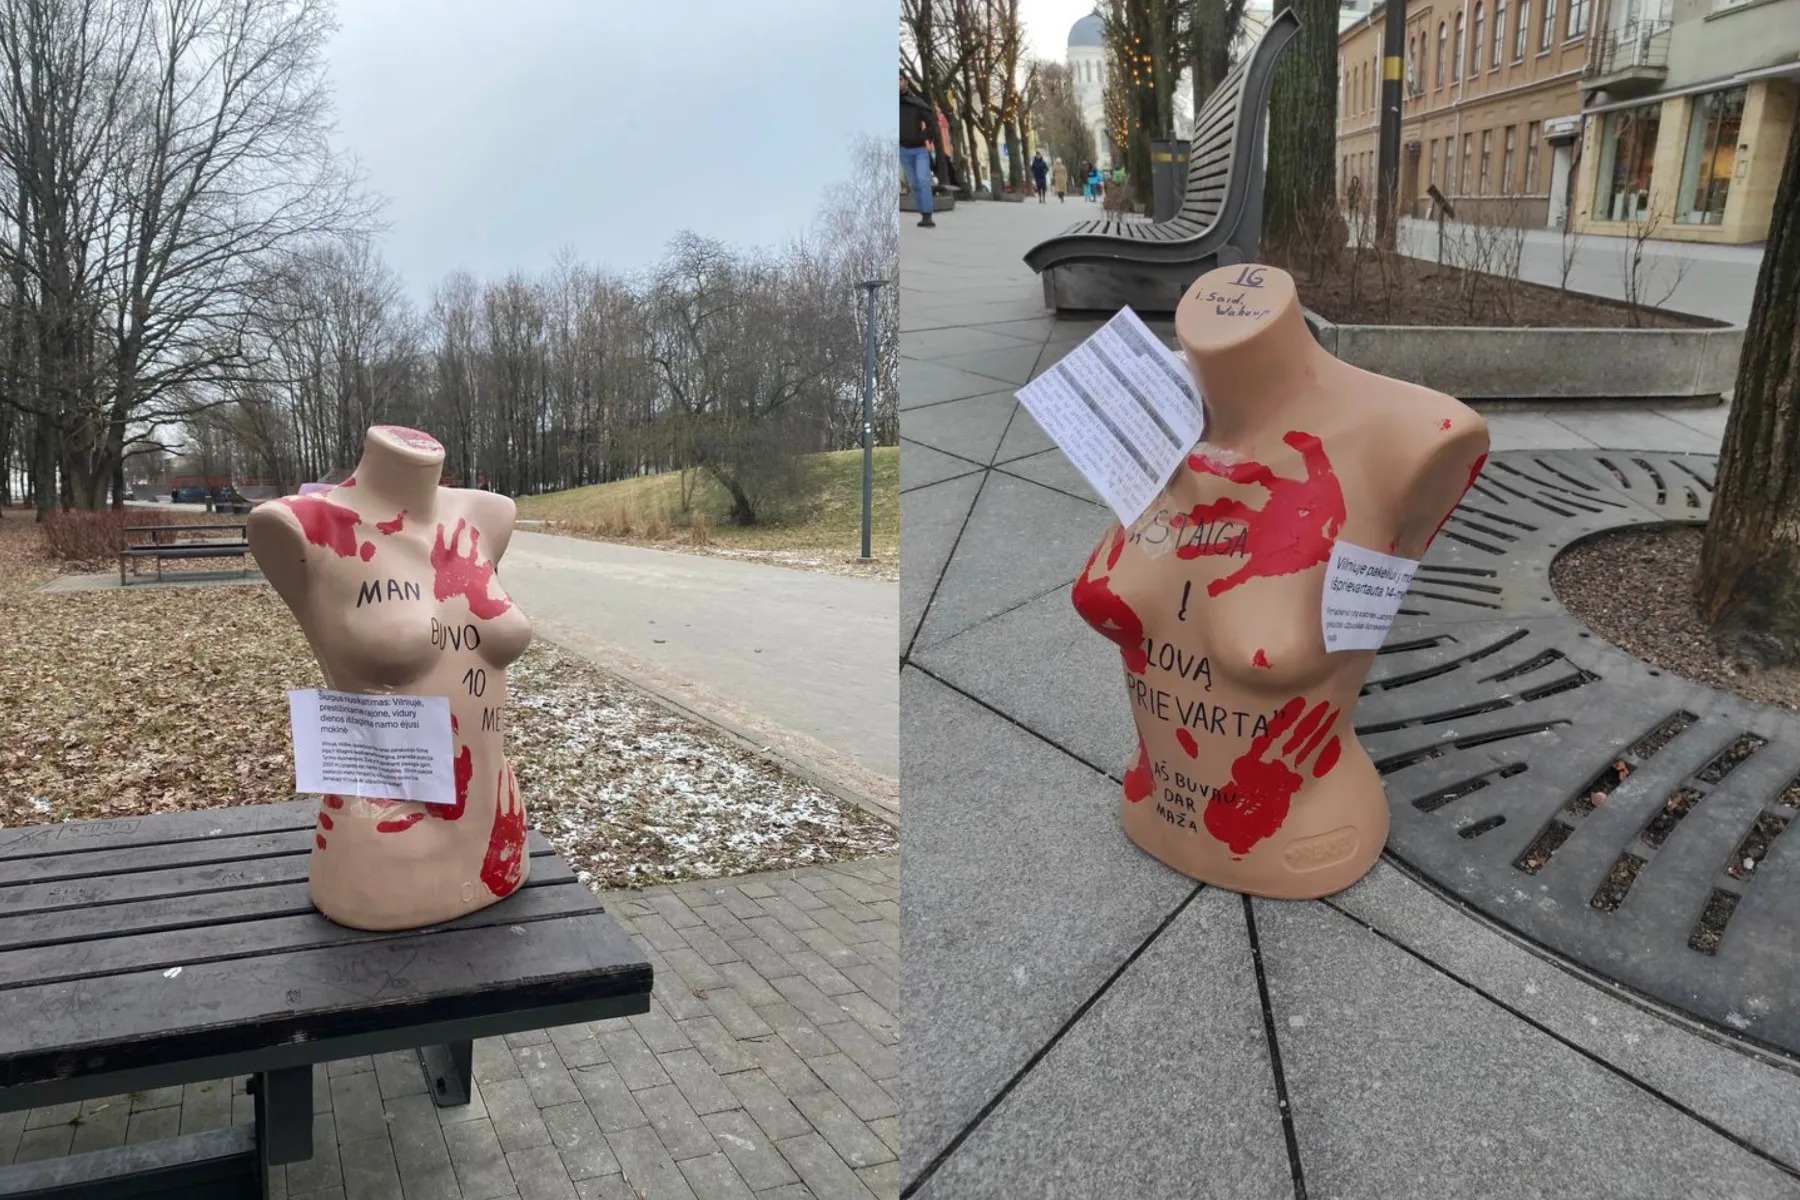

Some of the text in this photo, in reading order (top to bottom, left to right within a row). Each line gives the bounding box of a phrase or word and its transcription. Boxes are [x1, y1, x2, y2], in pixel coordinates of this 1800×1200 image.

[356, 578, 421, 608] MAN
[430, 616, 481, 651] BUVO
[1147, 638, 1213, 692] LOVĄ
[462, 668, 487, 698] 10
[320, 714, 345, 723] dienos
[374, 721, 399, 729] namo
[391, 709, 417, 719] vidury
[1154, 760, 1237, 804] AŠ BUVAU
[1164, 788, 1197, 814] DAR
[1156, 802, 1198, 833] MAŽA
